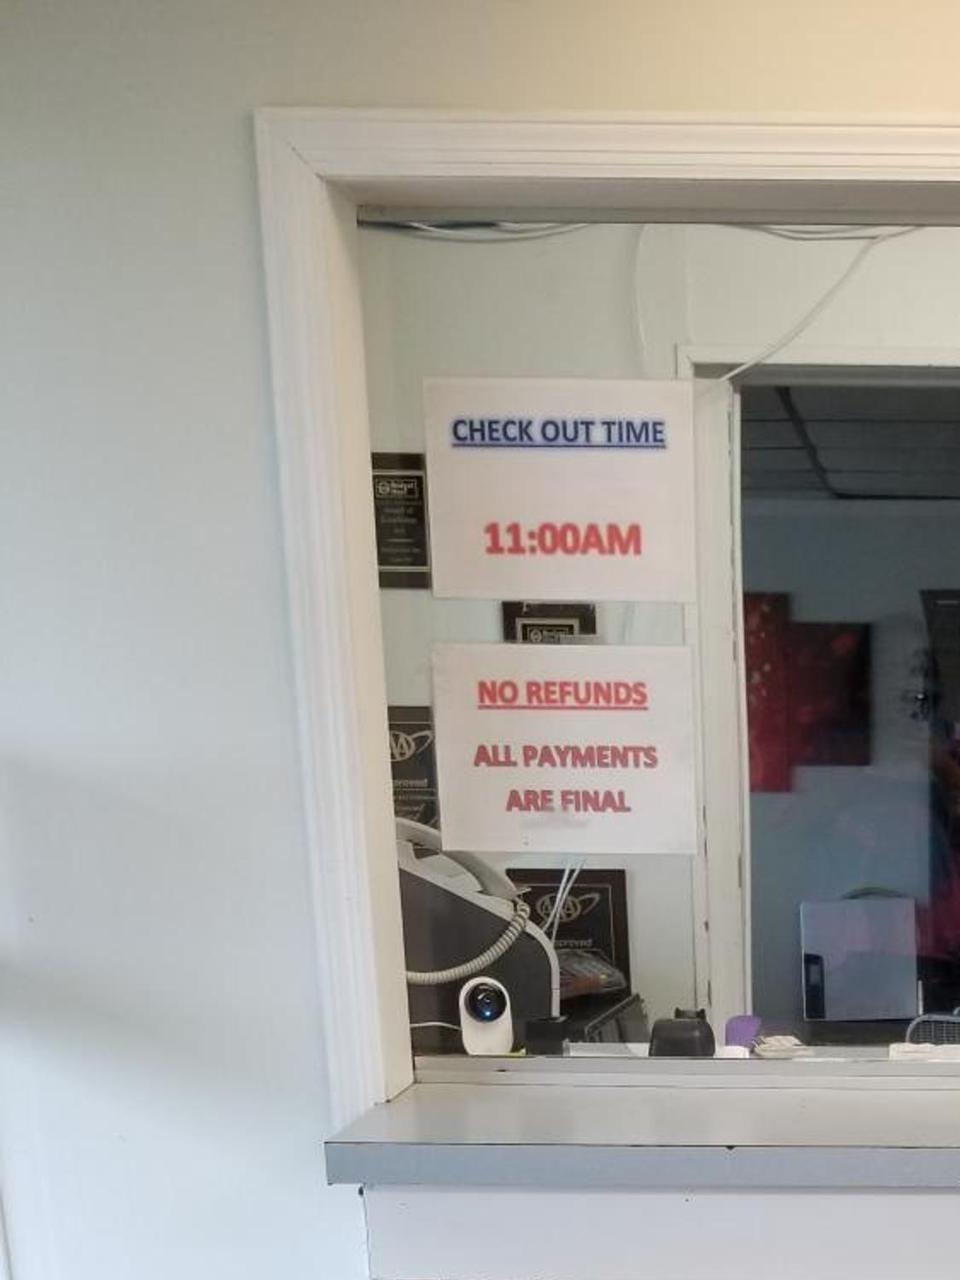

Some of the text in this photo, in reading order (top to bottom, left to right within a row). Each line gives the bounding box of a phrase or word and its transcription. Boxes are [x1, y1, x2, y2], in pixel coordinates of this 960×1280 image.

[453, 418, 665, 443] CHECK OUT TIME
[484, 523, 642, 555] 11:00AM
[478, 681, 648, 706] NO REFUNDS
[474, 746, 658, 768] ALL PAYMENTS
[506, 790, 631, 812] ARE FINAL
